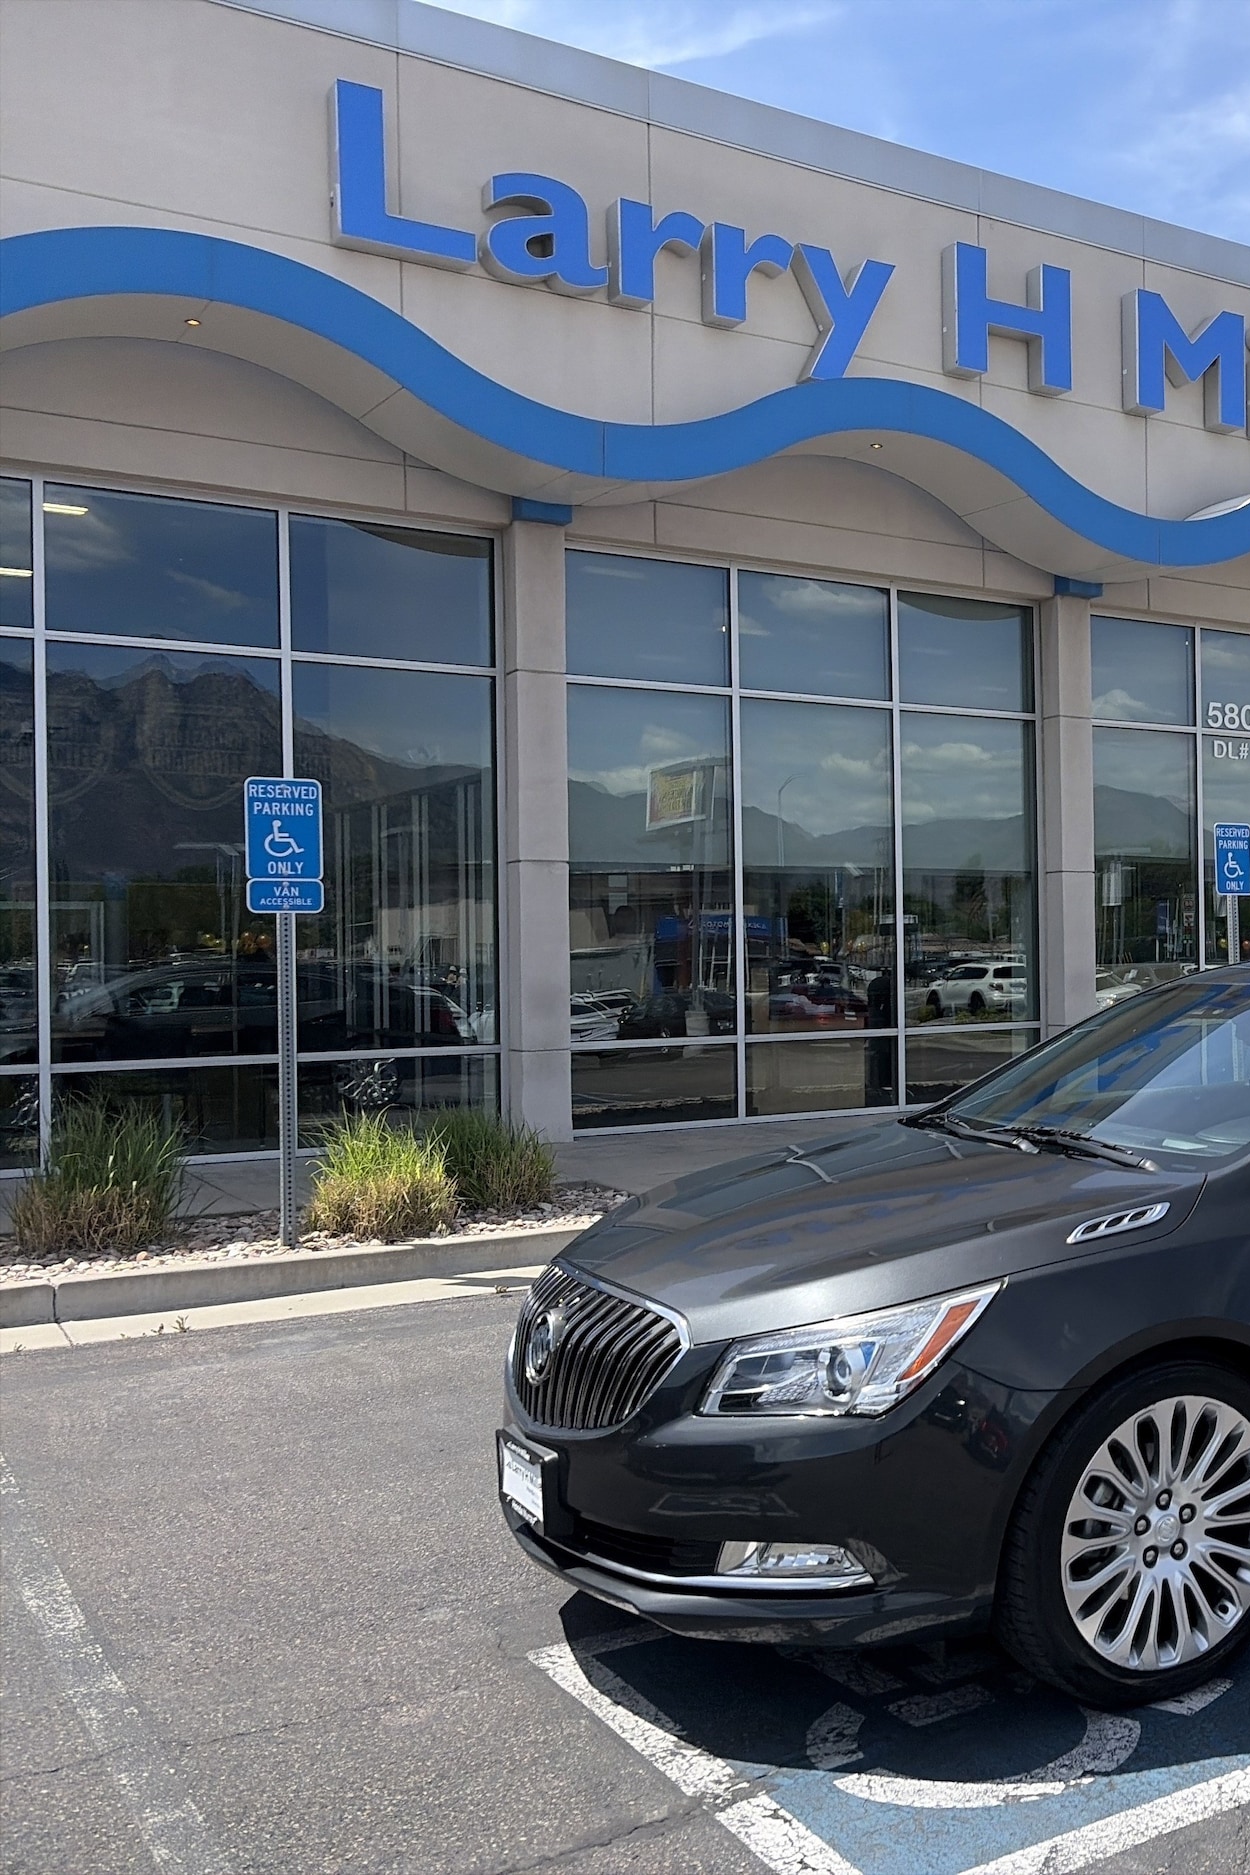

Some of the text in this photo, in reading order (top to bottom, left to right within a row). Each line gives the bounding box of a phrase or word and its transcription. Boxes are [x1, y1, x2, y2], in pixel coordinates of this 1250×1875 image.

[329, 79, 895, 384] Larry
[941, 241, 1072, 396] H
[1213, 740, 1249, 760] DL#
[249, 784, 317, 799] RESERVED
[253, 802, 314, 816] PARKING
[1216, 828, 1250, 838] RESERVED
[1218, 840, 1249, 850] PARKING
[267, 861, 304, 875] ONLY
[1225, 881, 1244, 890] ONLY
[273, 887, 299, 897] VAN
[260, 898, 312, 906] ACCESSIBLE
